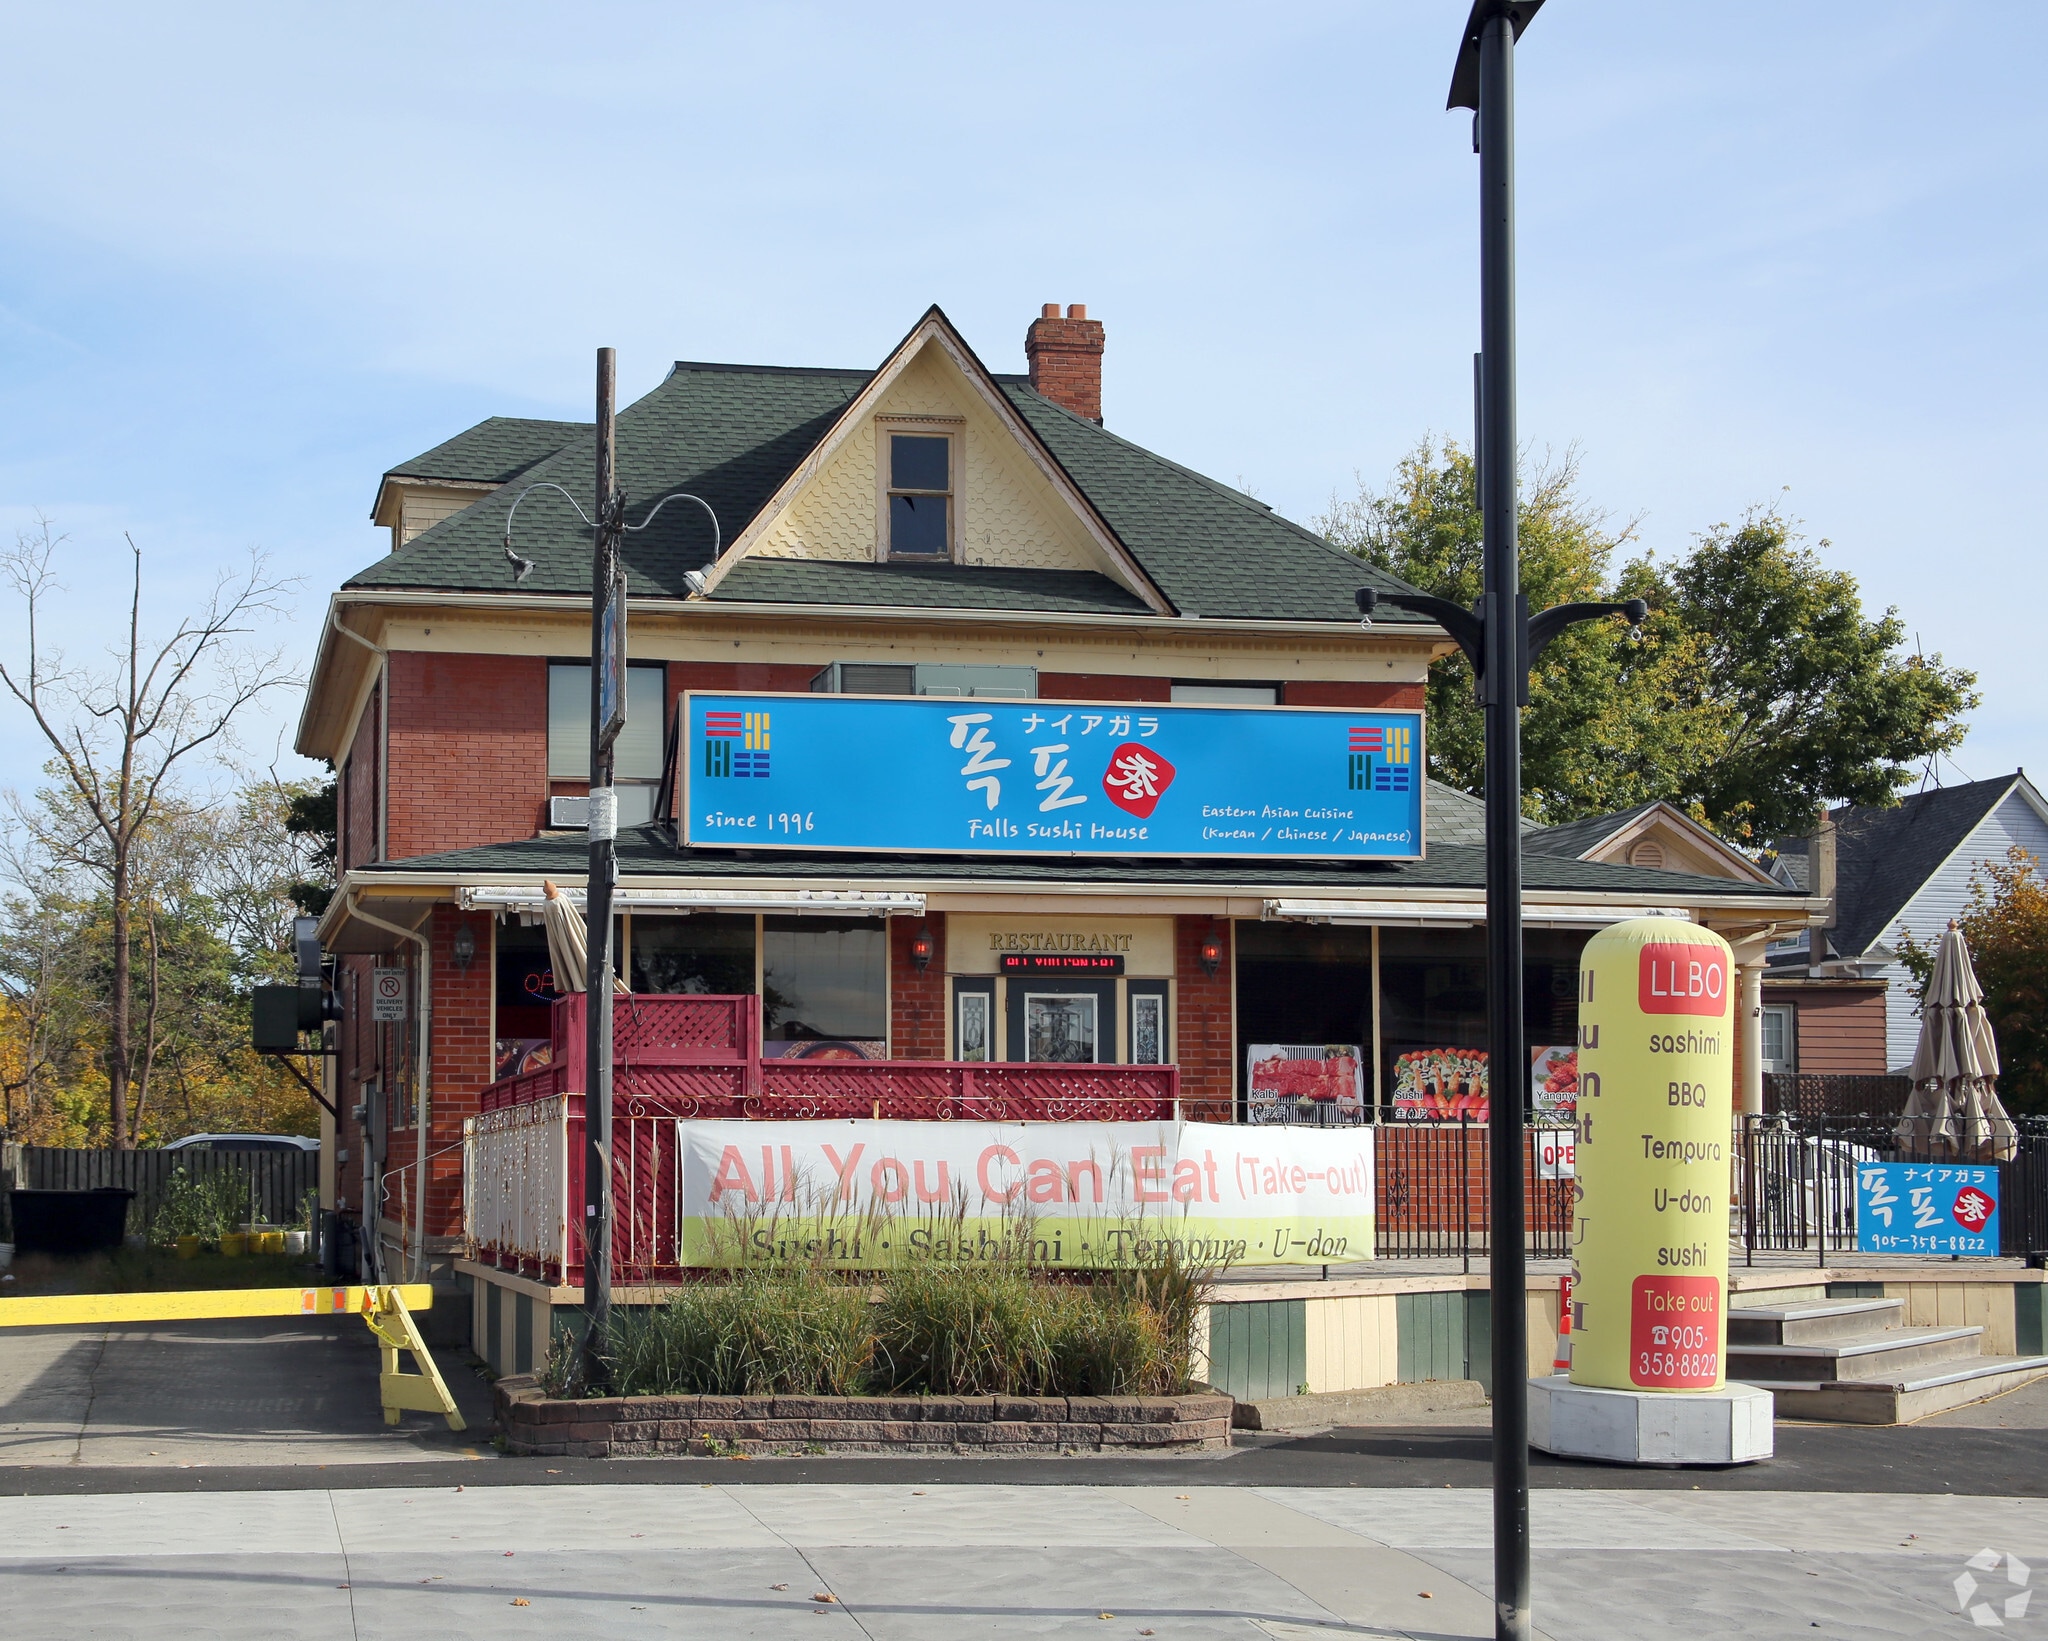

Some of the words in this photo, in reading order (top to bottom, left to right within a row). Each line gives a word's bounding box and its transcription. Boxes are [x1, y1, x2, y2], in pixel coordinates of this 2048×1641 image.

[1022, 713, 1159, 737] ナイアガラ
[1202, 805, 1256, 818] Eastern
[1261, 804, 1299, 818] Asian
[705, 811, 757, 828] since
[768, 811, 814, 834] 1996
[968, 818, 1018, 839] Falls
[1026, 820, 1082, 840] Sushi
[1091, 823, 1149, 840] House
[1202, 826, 1256, 840] (Korean
[1277, 827, 1327, 840] Chinese
[1348, 829, 1412, 844] Japanese)
[989, 932, 1133, 952] RESTAURANT
[1651, 960, 1722, 998] LLBO
[1649, 1030, 1720, 1056] sashimi
[1252, 1089, 1278, 1099] Kalbi
[1395, 1090, 1423, 1100] Sushi
[1537, 1091, 1577, 1103] Yangnye
[1668, 1082, 1706, 1108] BBQ
[1543, 1145, 1575, 1165] OPE
[1641, 1135, 1721, 1164] Tempura
[708, 1145, 794, 1203] All
[821, 1143, 951, 1204] You
[977, 1144, 1103, 1204] Can
[1131, 1146, 1219, 1203] Eat
[1235, 1152, 1368, 1199] (Take-out)
[1903, 1168, 1986, 1184] ナイアガラ
[1654, 1188, 1712, 1213] U-don
[752, 1229, 863, 1260] Sushi
[908, 1229, 1063, 1261] Sashimi
[1106, 1229, 1246, 1261] Tempura
[1272, 1228, 1347, 1258] U-don
[1872, 1233, 1985, 1250] 905-358-8822
[1657, 1243, 1707, 1266] sushi
[1644, 1290, 1685, 1312] Take
[1691, 1291, 1713, 1312] out
